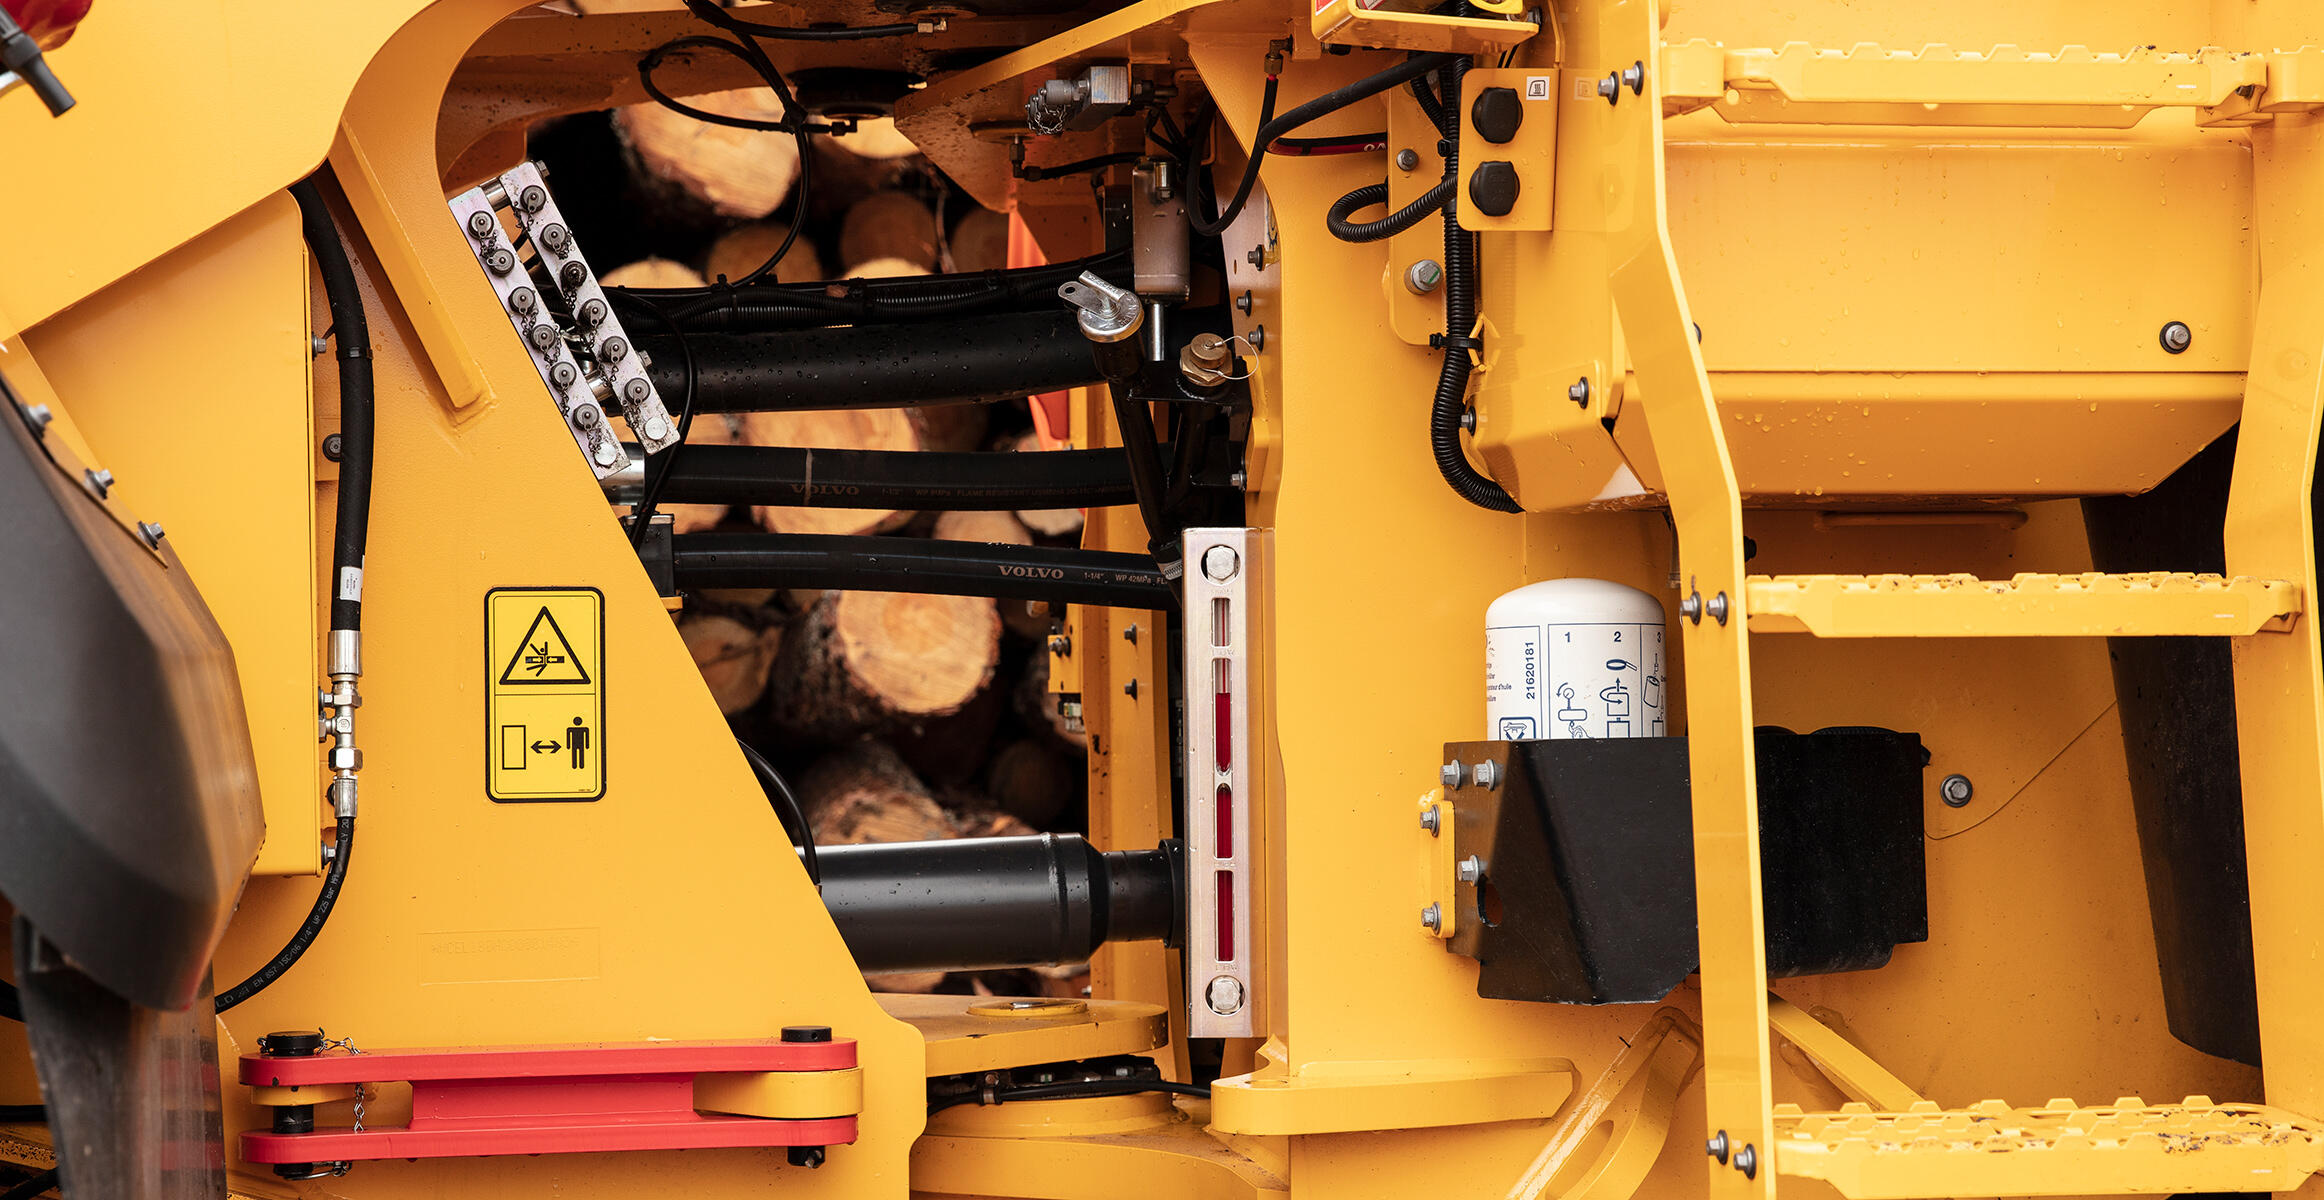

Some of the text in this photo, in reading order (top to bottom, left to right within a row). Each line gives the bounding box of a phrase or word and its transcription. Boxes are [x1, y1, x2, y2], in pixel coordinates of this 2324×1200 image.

[791, 483, 860, 496] VOLVO
[998, 565, 1064, 580] VOLVO
[1564, 632, 1571, 643] 1
[1613, 631, 1622, 642] 2
[1525, 641, 1536, 700] 21620181
